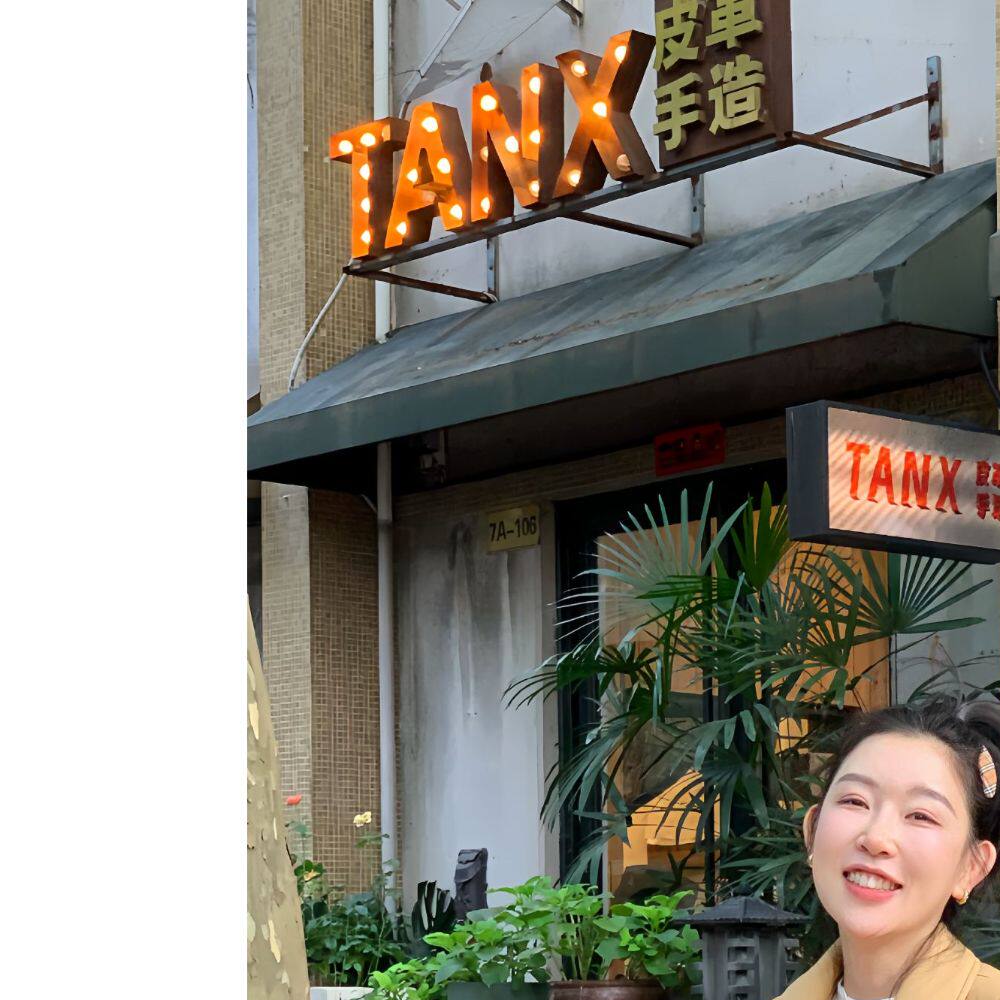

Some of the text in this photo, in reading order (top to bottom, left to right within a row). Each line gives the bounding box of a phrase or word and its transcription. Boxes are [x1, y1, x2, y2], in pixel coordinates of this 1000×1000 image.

[330, 30, 656, 259] TANX
[652, 54, 766, 151] 手造
[846, 440, 962, 515] TANX
